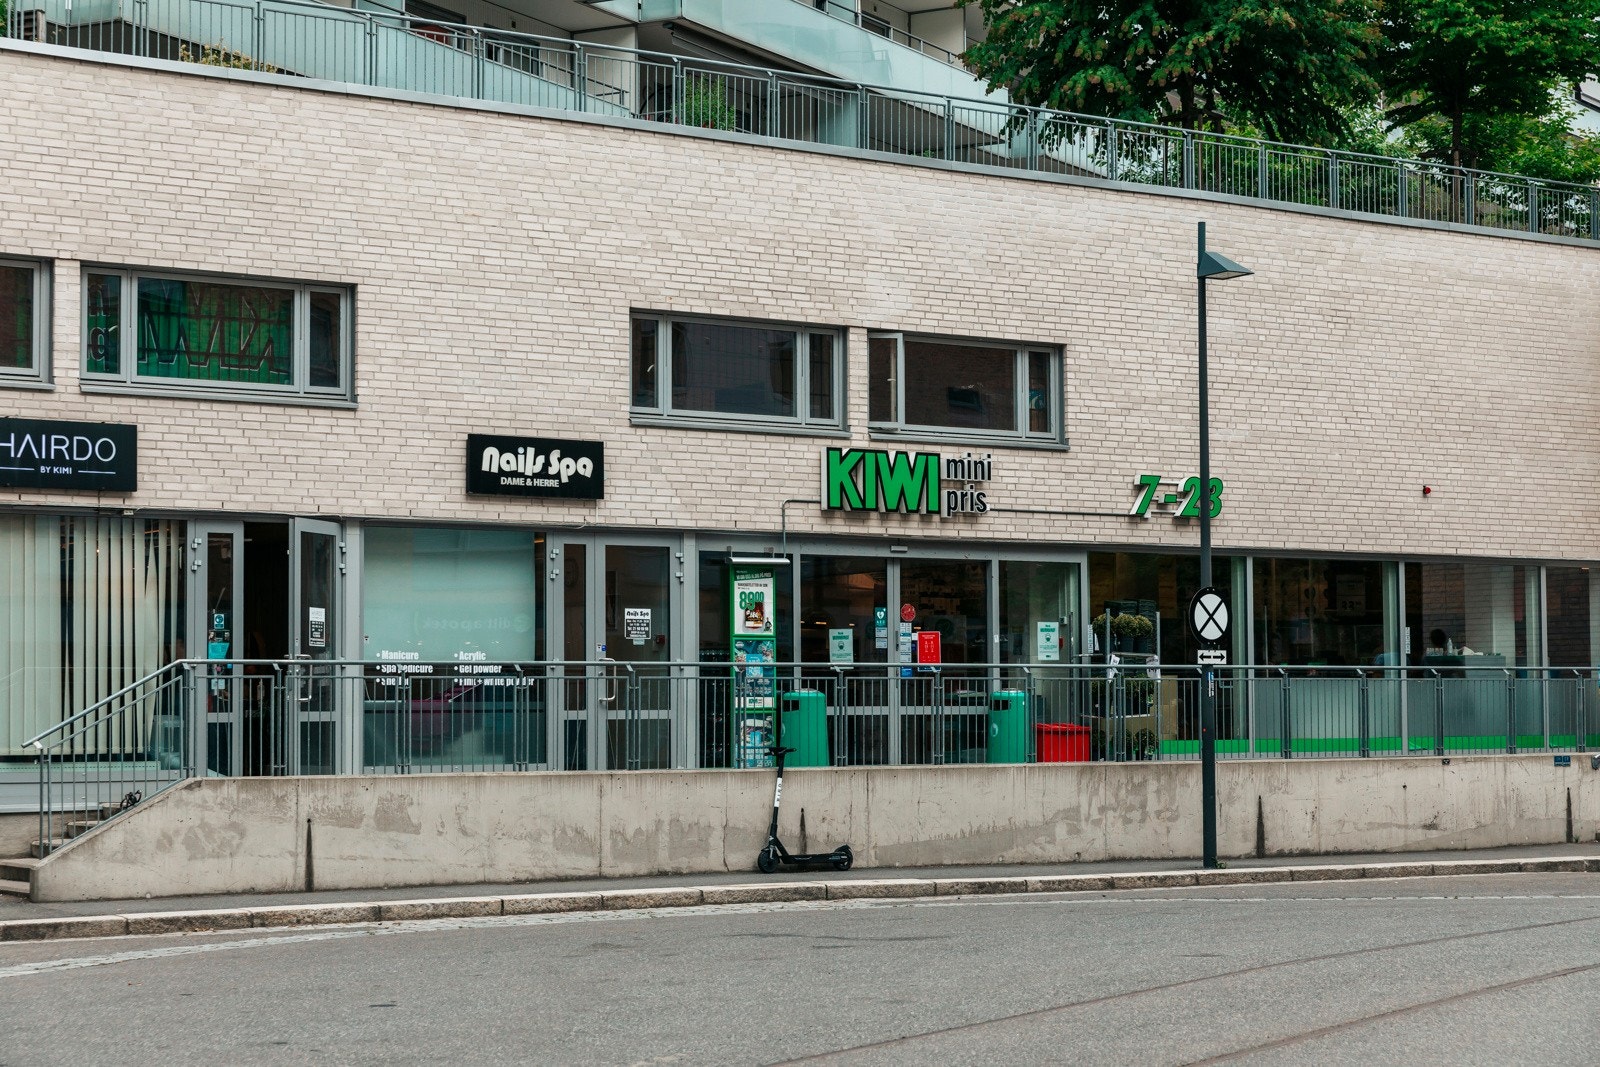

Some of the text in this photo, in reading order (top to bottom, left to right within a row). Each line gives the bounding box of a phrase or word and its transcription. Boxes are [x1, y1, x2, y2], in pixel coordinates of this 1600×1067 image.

[40, 466, 72, 475] BY KIMI
[548, 449, 594, 483] Spa
[946, 452, 991, 481] mini
[500, 477, 560, 488] DAME & HERRE
[826, 446, 941, 514] KIWI
[946, 484, 988, 517] pris
[381, 650, 419, 660] Manicure
[459, 650, 486, 661] Acrylic
[381, 664, 397, 673] Spa
[459, 664, 502, 674] Gel powder
